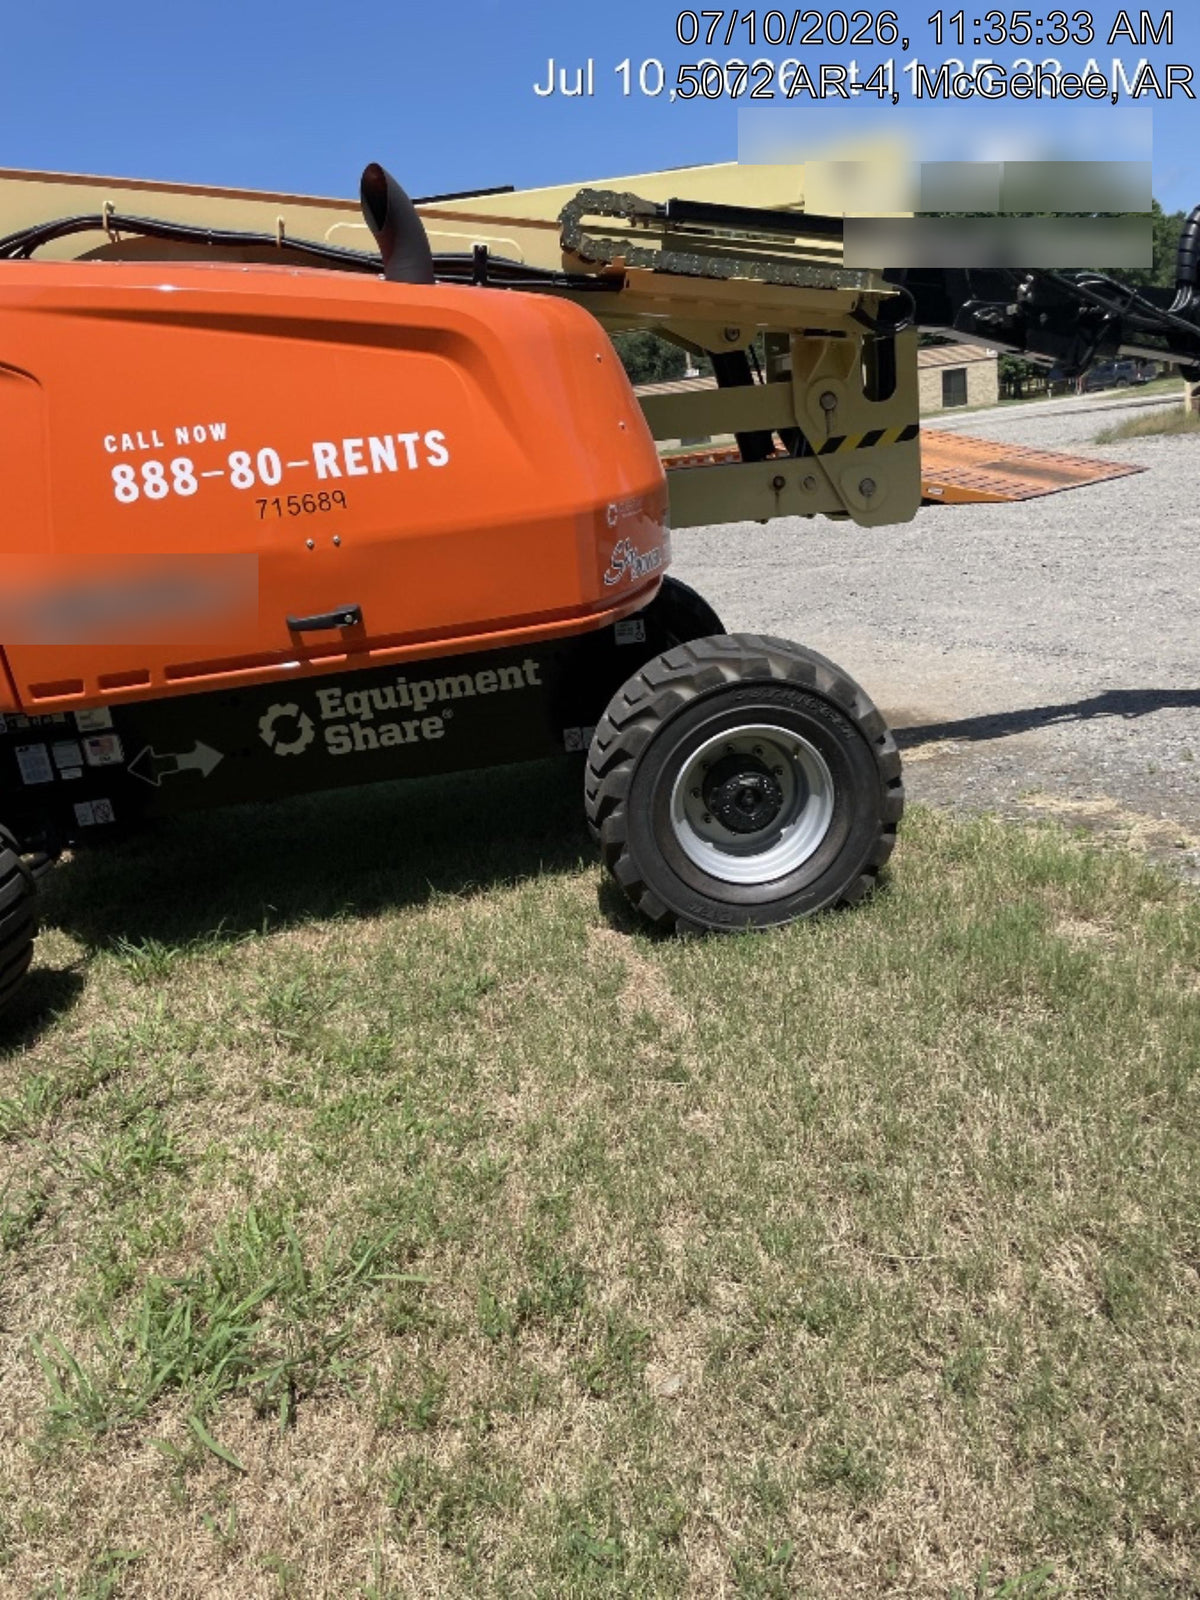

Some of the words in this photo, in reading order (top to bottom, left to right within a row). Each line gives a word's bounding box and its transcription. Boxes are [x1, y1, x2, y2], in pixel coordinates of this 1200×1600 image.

[103, 429, 165, 453] CALL
[174, 422, 228, 446] NOW
[110, 429, 450, 504] 888-80-RENTS
[255, 490, 348, 520] 715689
[315, 658, 543, 721] Equipment
